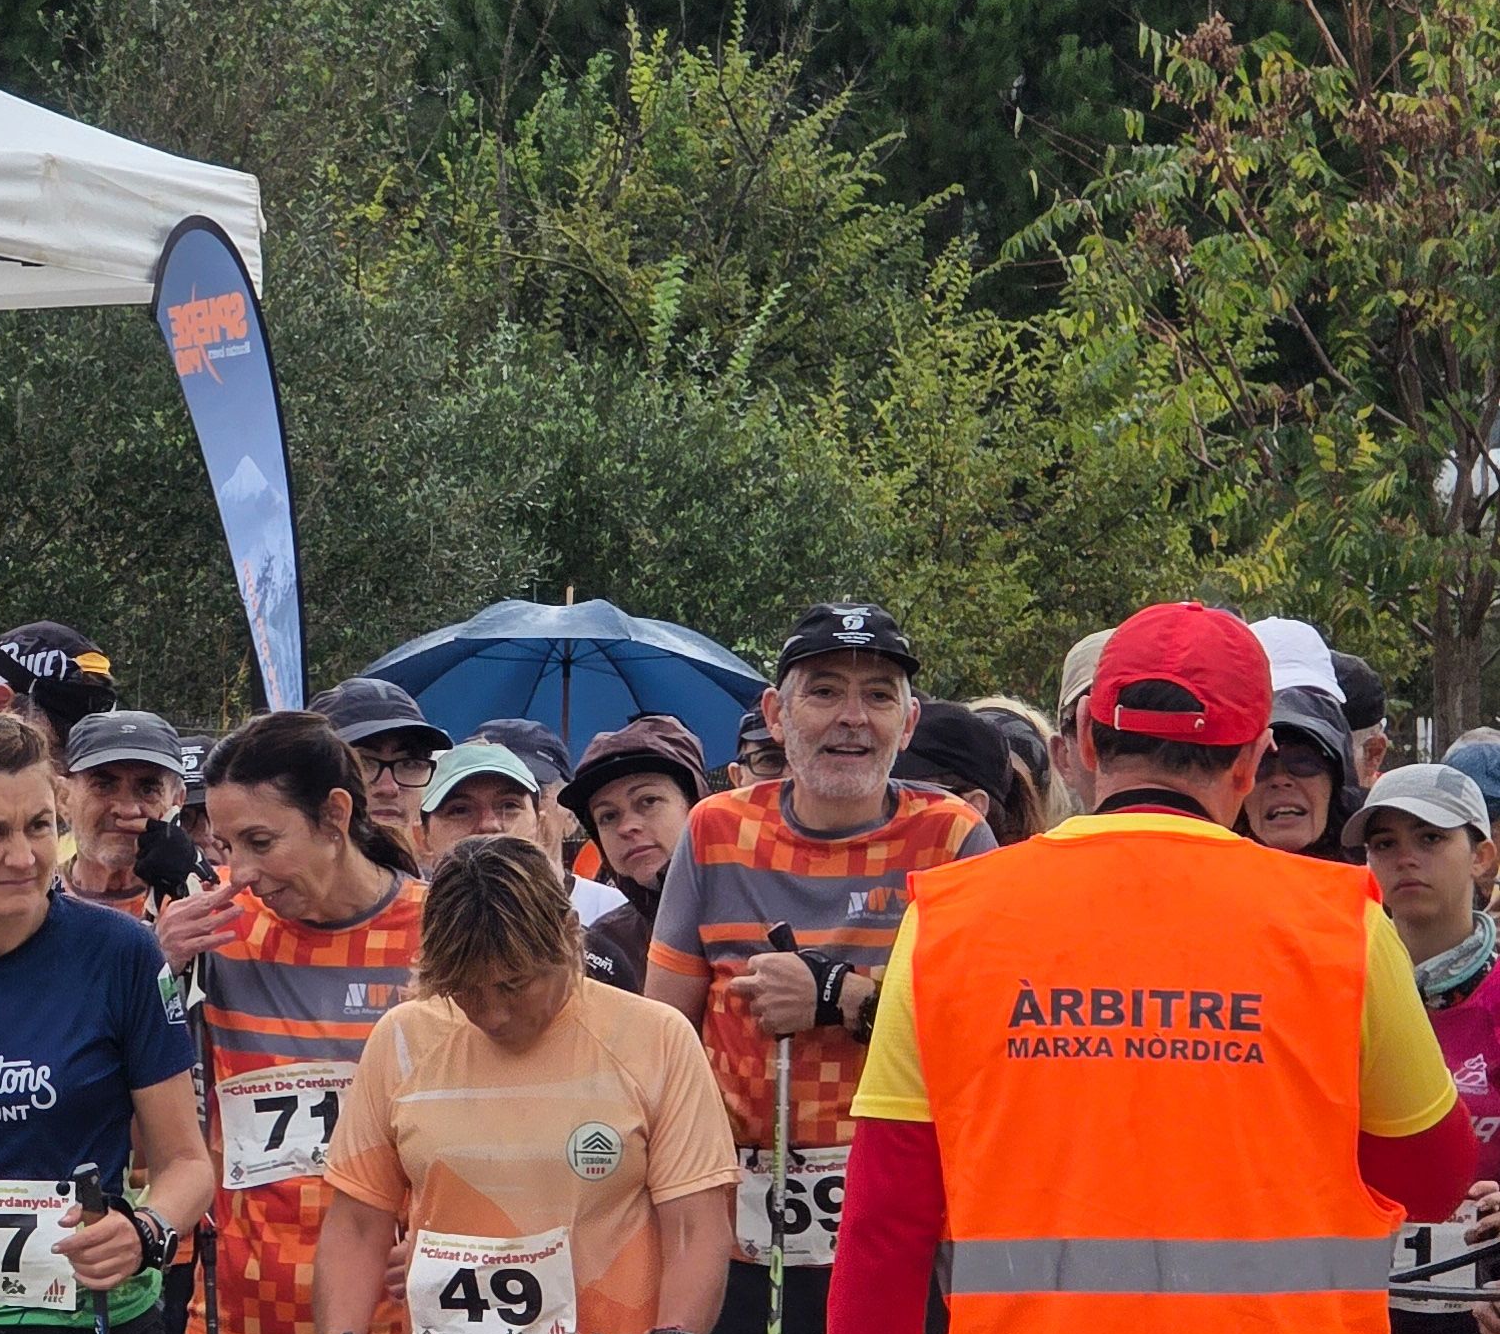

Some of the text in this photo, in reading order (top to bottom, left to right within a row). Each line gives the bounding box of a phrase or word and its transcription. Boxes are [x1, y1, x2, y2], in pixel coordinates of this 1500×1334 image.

[1007, 978, 1263, 1033] ÀRBITRE
[1007, 1033, 1265, 1064] MARXA NÒRDICA
[275, 1081, 293, 1091] De
[253, 1091, 340, 1152] 71
[765, 1175, 846, 1235] 69
[463, 1252, 479, 1264] De
[439, 1267, 543, 1326] 49
